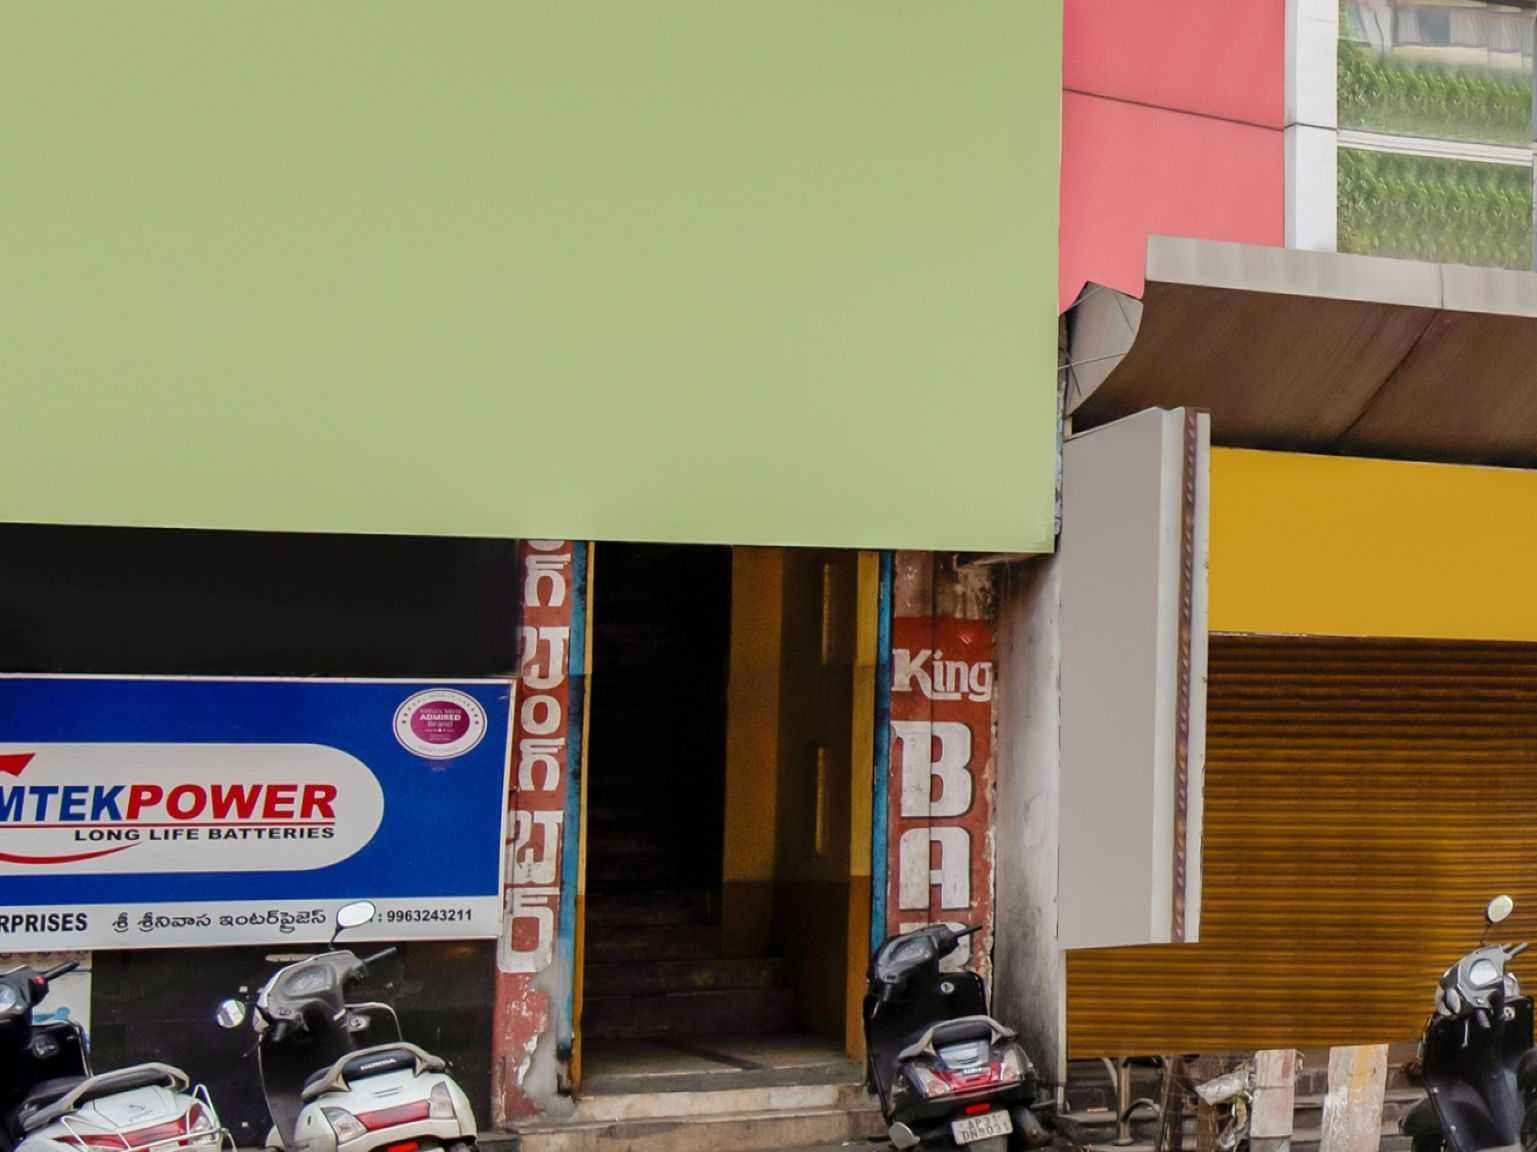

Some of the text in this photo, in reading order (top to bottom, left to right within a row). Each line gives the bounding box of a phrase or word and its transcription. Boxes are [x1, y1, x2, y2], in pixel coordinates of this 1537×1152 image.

[891, 649, 993, 702] King
[420, 713, 461, 721] ADMIRED
[75, 827, 336, 842] LONG LIFE BATTERIES
[386, 908, 473, 923] 9963243211
